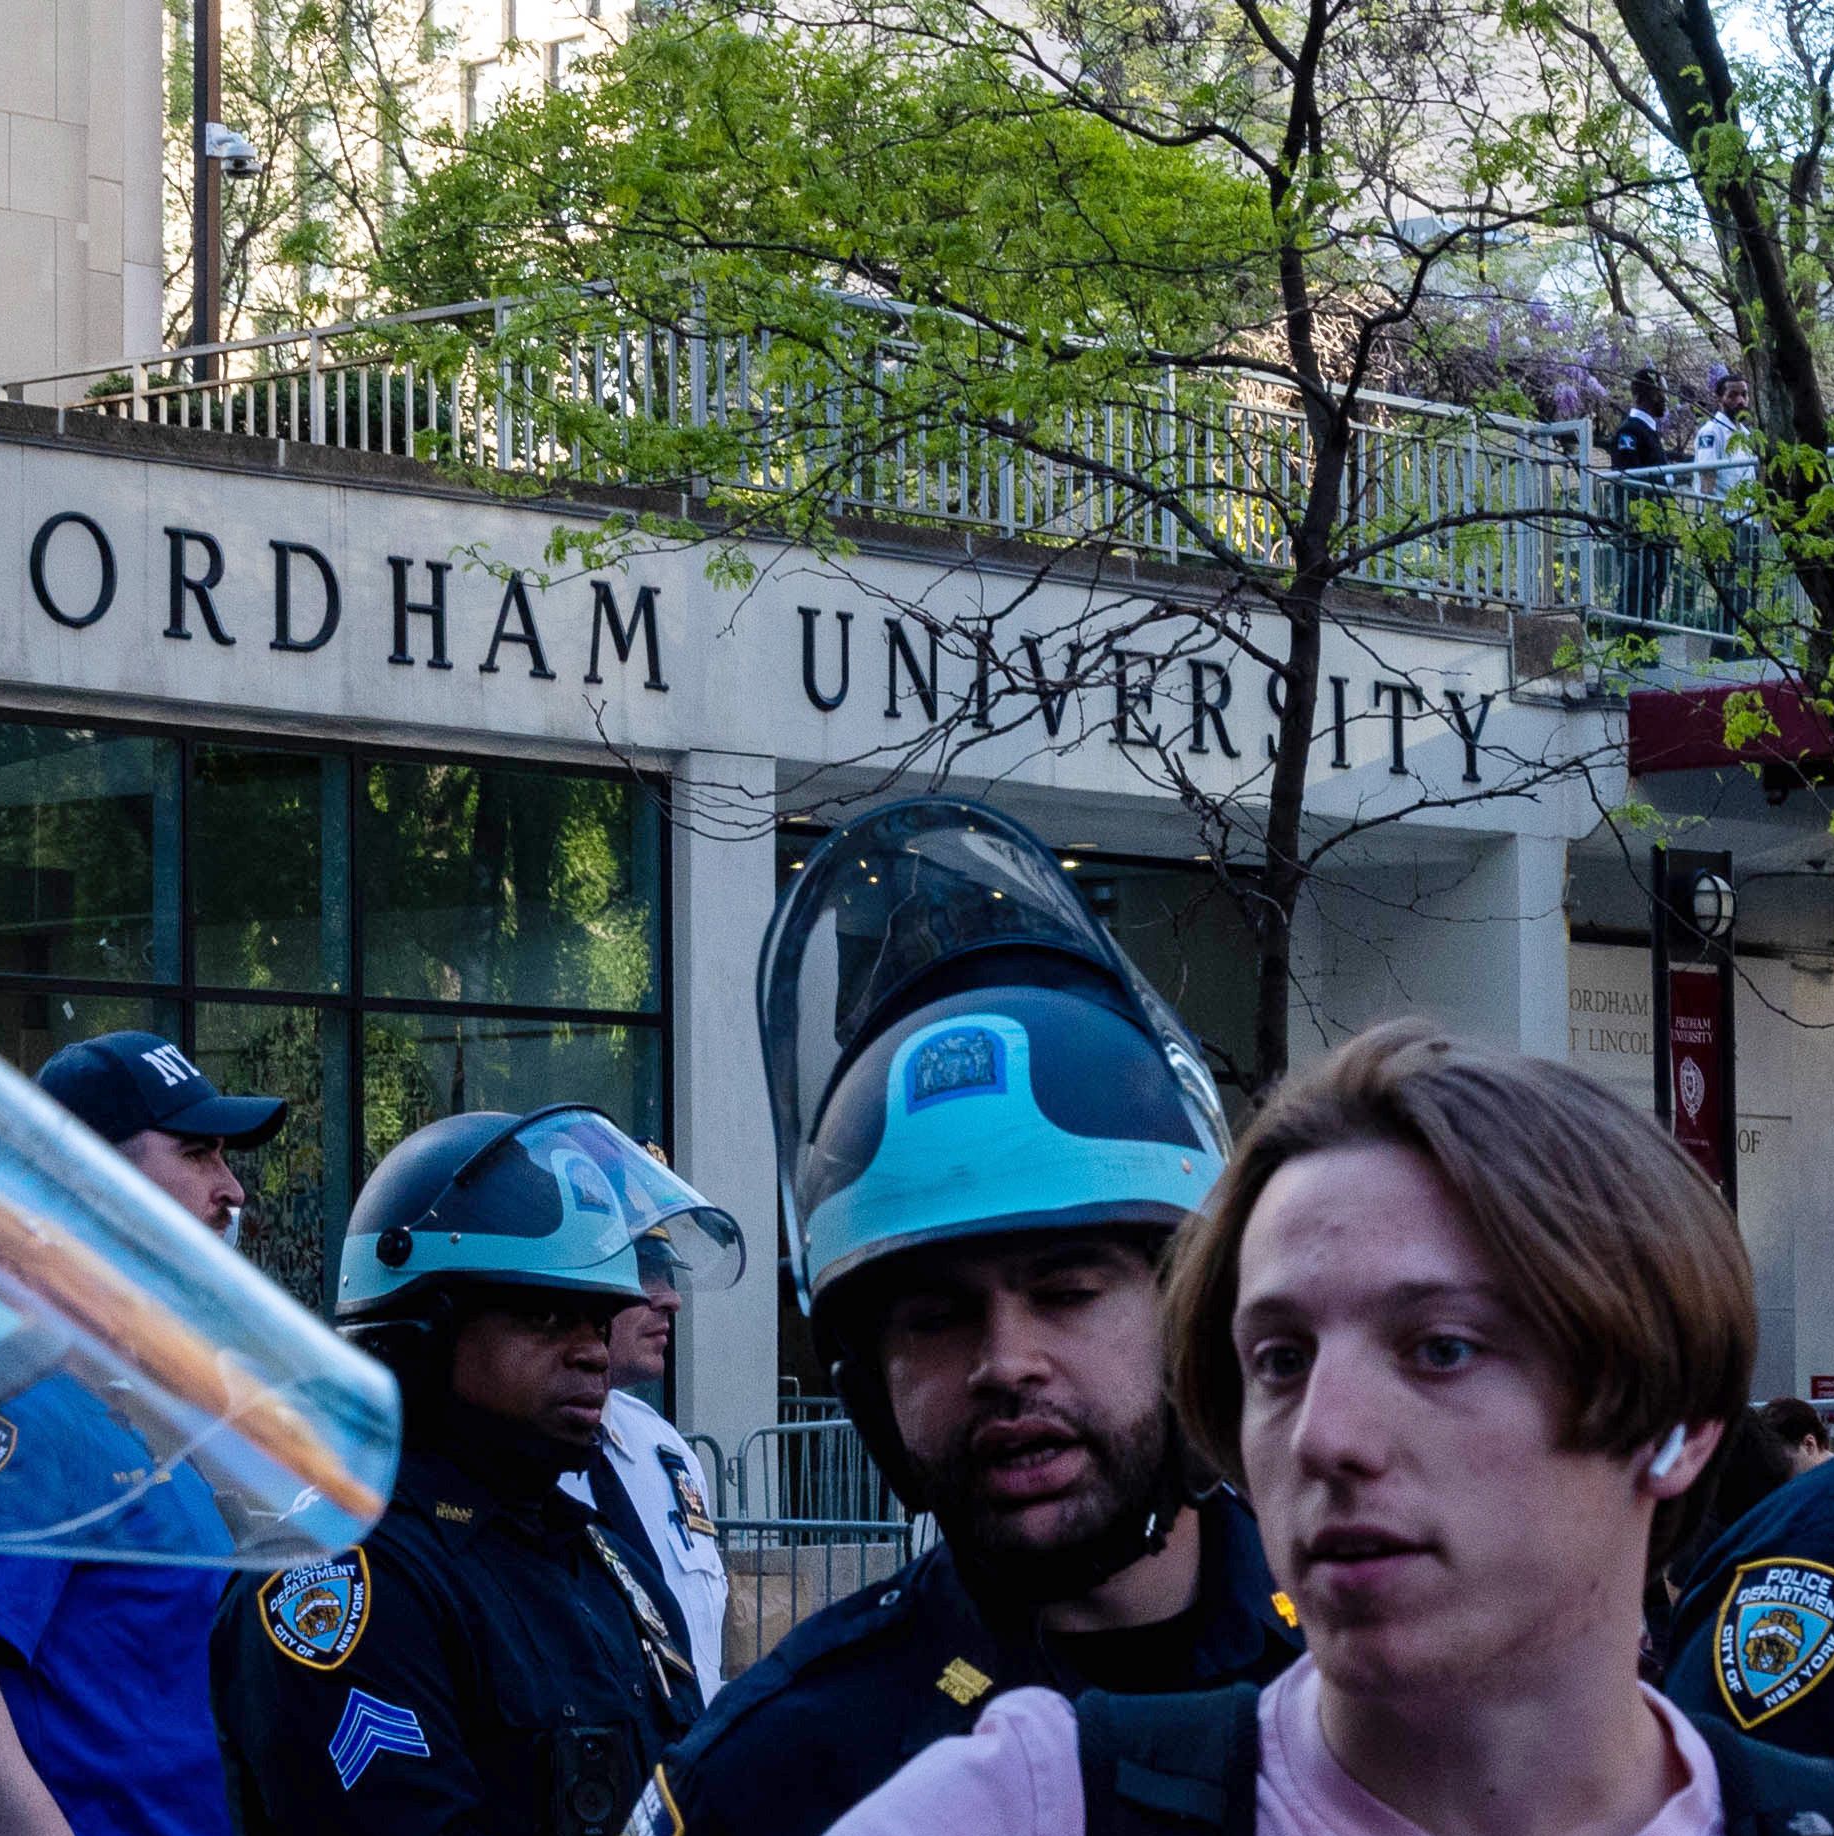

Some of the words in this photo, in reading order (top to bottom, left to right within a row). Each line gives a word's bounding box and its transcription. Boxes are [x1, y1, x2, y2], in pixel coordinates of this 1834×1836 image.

[1570, 989, 1649, 1016] ORDHAM
[1589, 1031, 1654, 1055] LINCOL
[1737, 1129, 1761, 1154] OF
[269, 1564, 356, 1613] DEPARTMENT
[1764, 1567, 1833, 1596] POLICE
[335, 1624, 356, 1653] NEW
[349, 1582, 364, 1621] YORK
[274, 1624, 297, 1647] CITY
[296, 1643, 315, 1658] OF
[1721, 1624, 1735, 1665] CITY
[1725, 1669, 1743, 1694] OF
[1763, 1677, 1801, 1708] NEW
